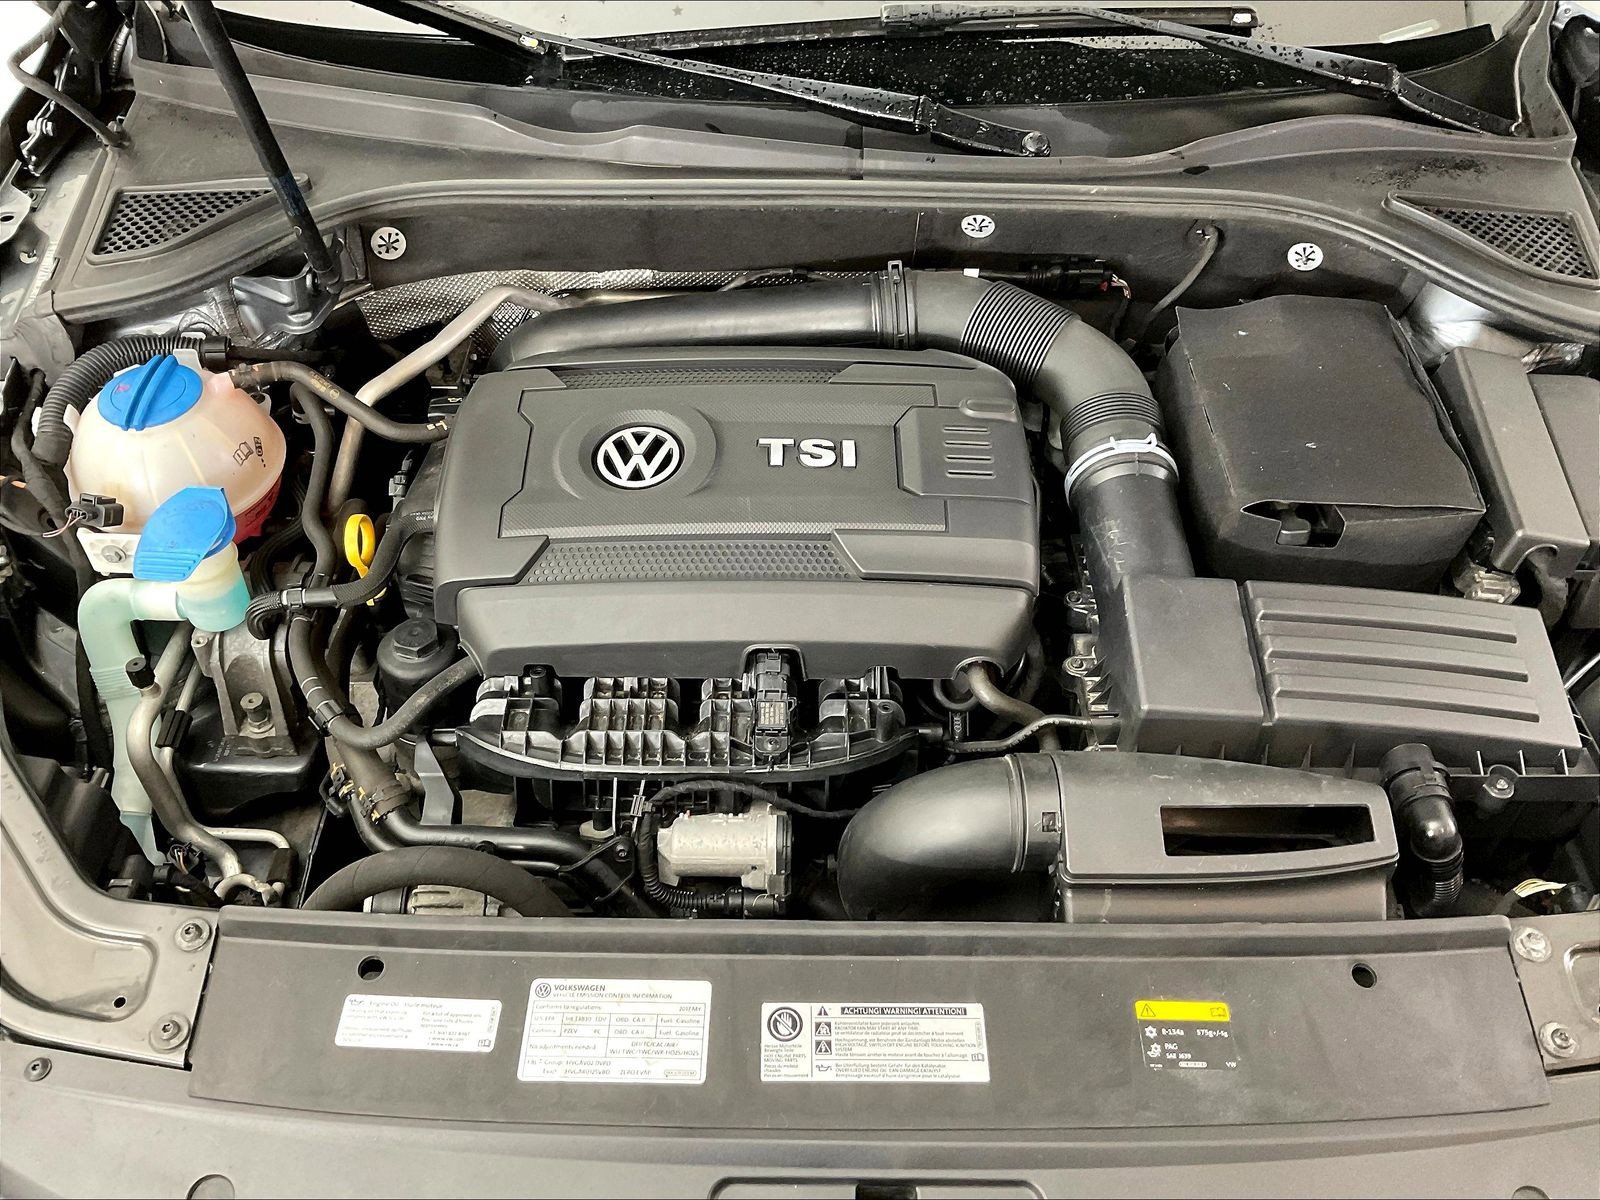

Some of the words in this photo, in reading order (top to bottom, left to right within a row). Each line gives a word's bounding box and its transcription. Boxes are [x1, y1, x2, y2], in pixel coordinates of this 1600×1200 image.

[757, 438, 857, 468] TSI
[554, 984, 606, 992] VOLKSWAGEN
[844, 1007, 882, 1015] ACHTUNG!
[883, 1007, 920, 1015] WARNING!
[921, 1007, 965, 1015] ATTENTION!
[1161, 1028, 1185, 1036] R-134a
